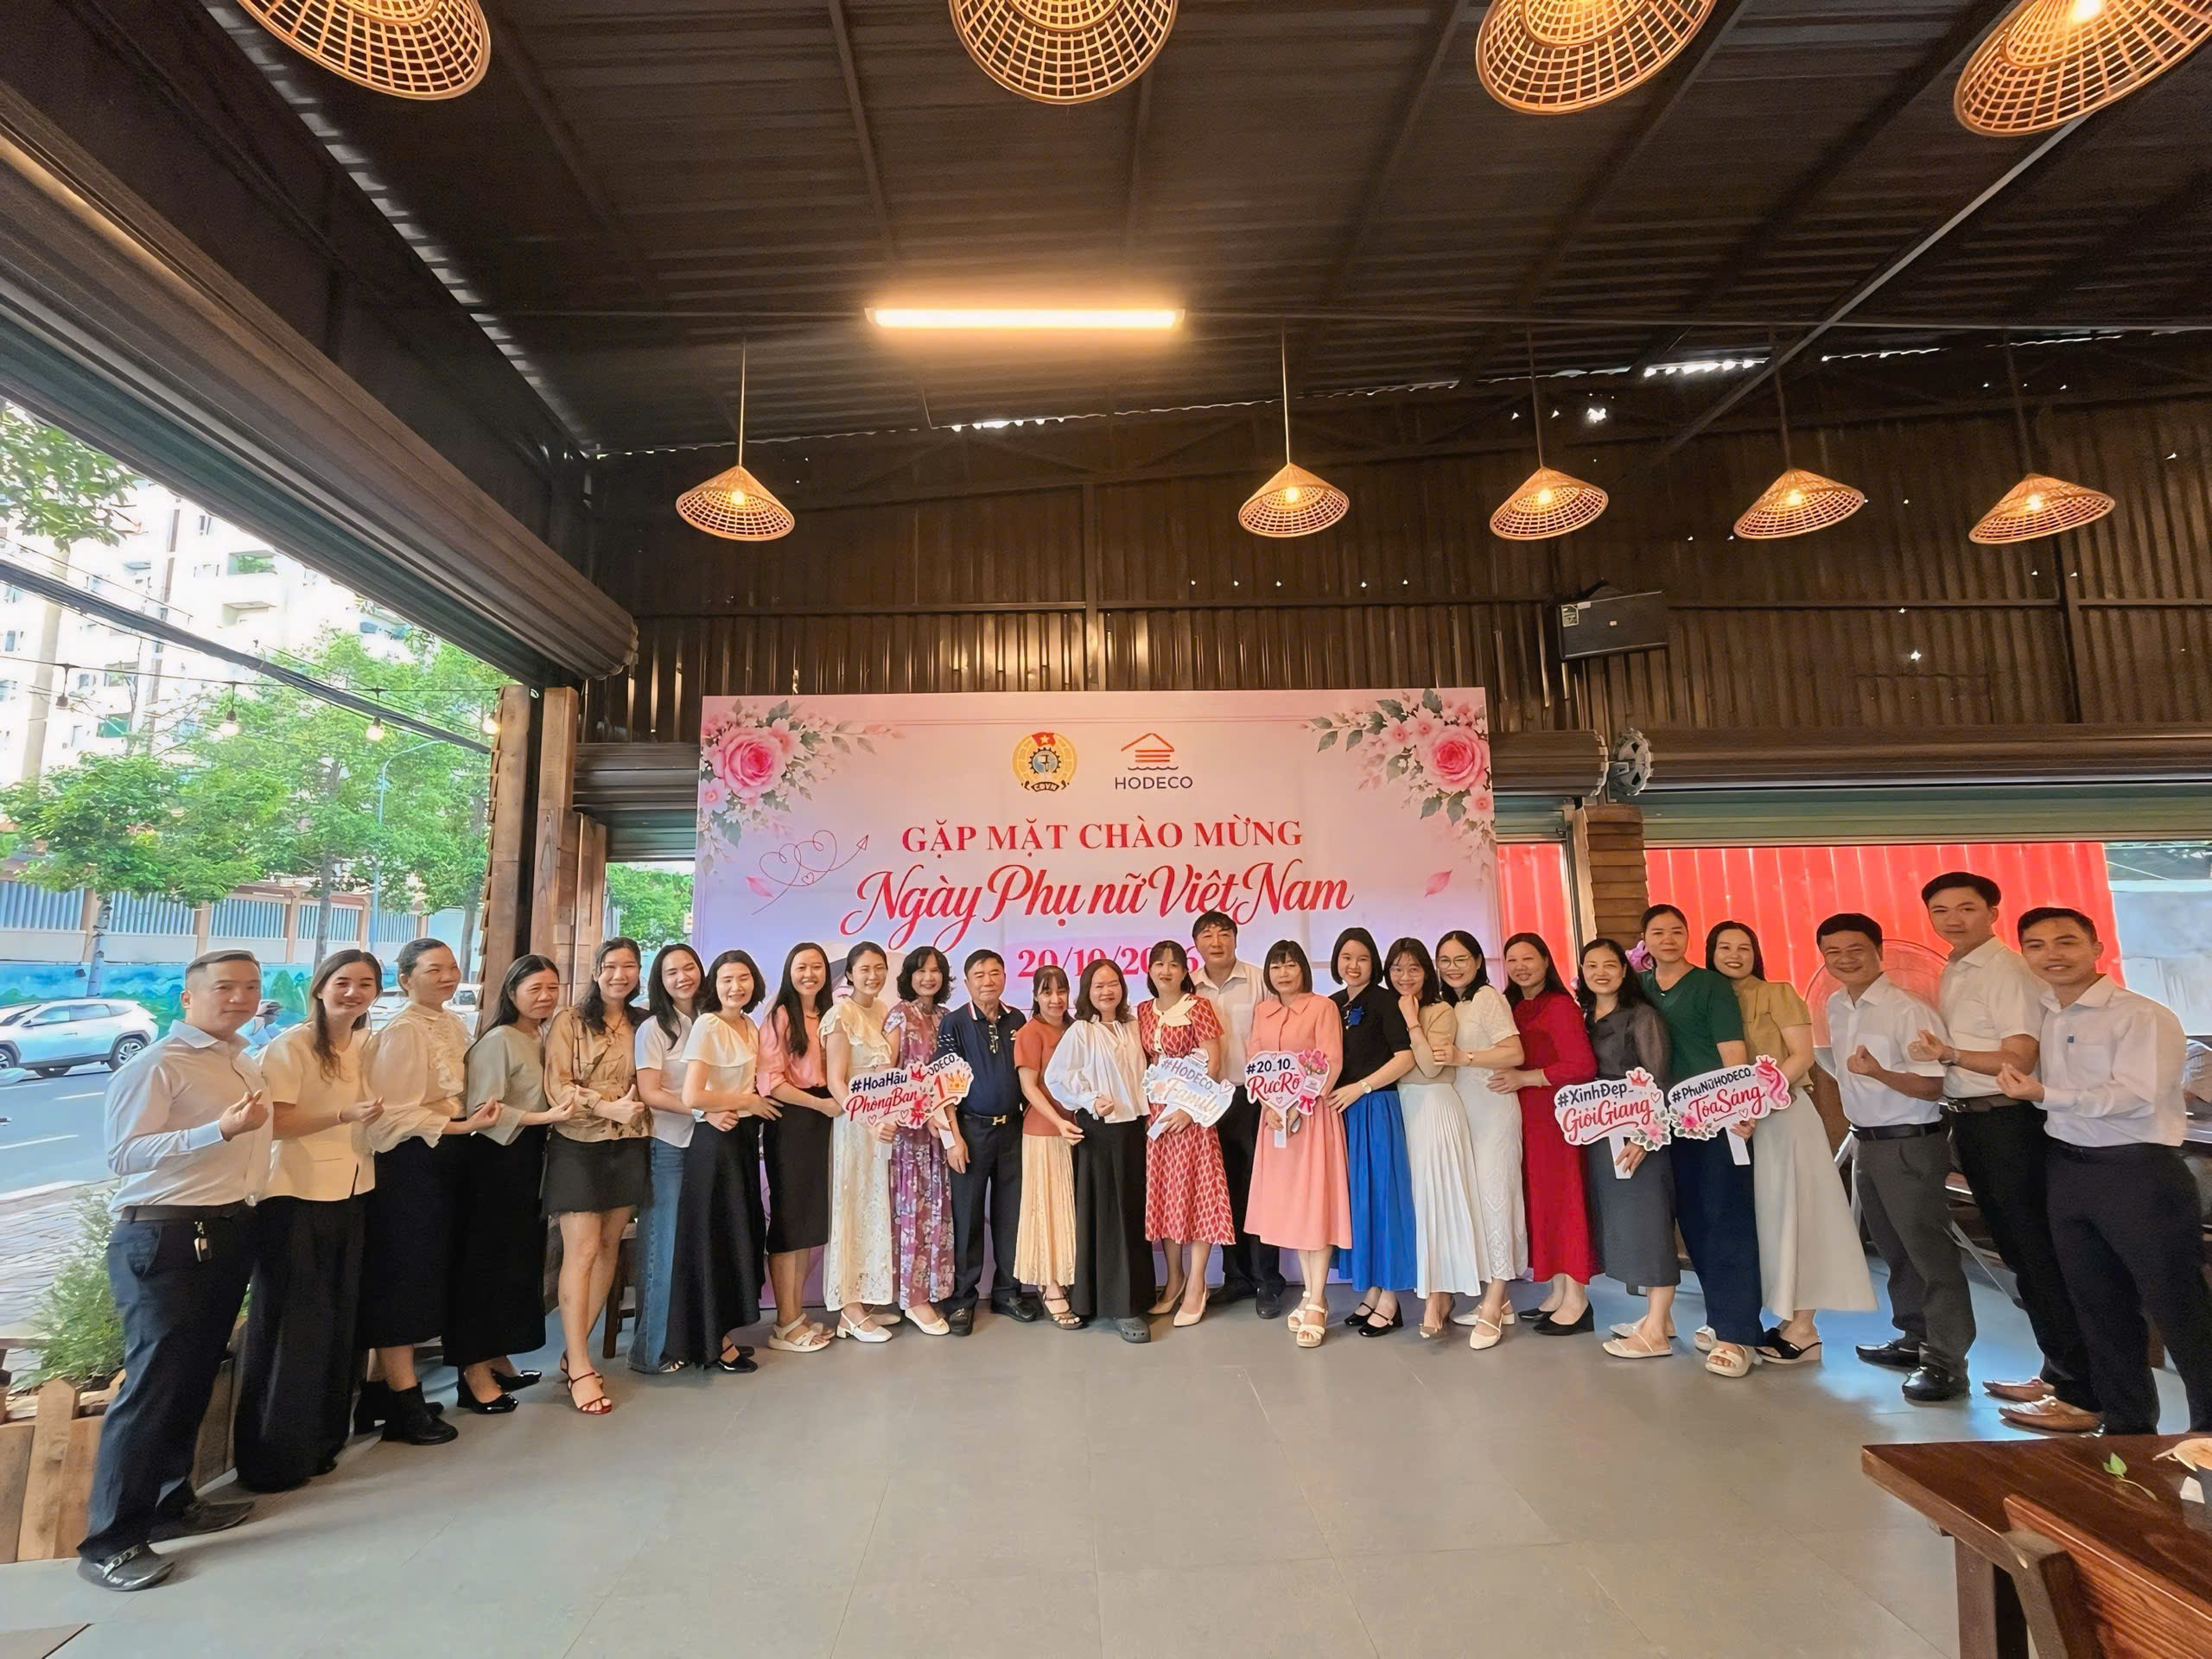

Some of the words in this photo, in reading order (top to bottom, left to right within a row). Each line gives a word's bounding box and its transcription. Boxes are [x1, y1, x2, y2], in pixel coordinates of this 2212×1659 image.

[1115, 776, 1193, 790] HODECO
[901, 818, 977, 859] GẶP
[986, 817, 1069, 858] MẶT
[1078, 815, 1184, 850] CHÀO
[1193, 814, 1303, 847] MỪNG
[839, 864, 983, 953] Ngày
[982, 864, 1086, 927] Phụ
[1086, 872, 1149, 915] nữ
[1231, 858, 1355, 925] Nam
[845, 1085, 918, 1122] PhòngBan
